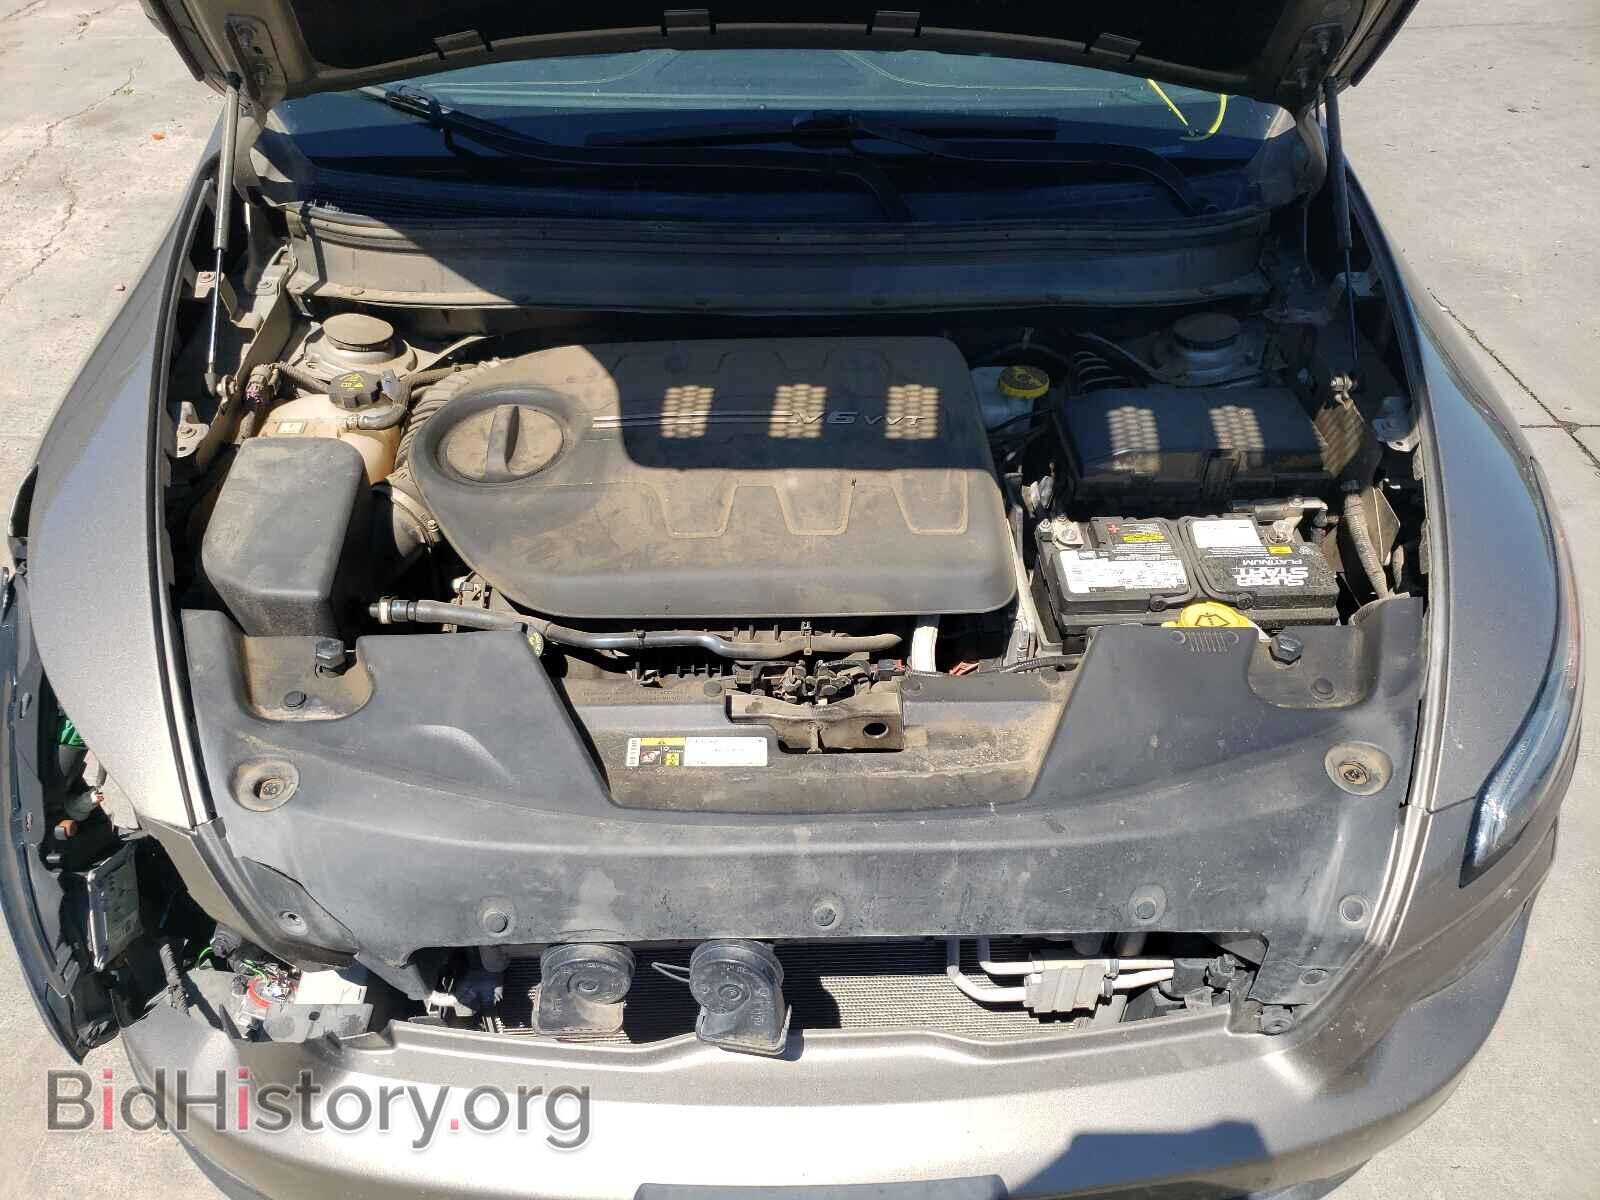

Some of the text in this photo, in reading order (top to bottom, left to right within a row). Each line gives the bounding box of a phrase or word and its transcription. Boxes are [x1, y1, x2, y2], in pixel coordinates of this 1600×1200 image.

[797, 411, 926, 426] V6 VVT
[1242, 558, 1303, 566] PLATINUM
[1239, 566, 1309, 578] START
[1236, 576, 1305, 587] SUPER
